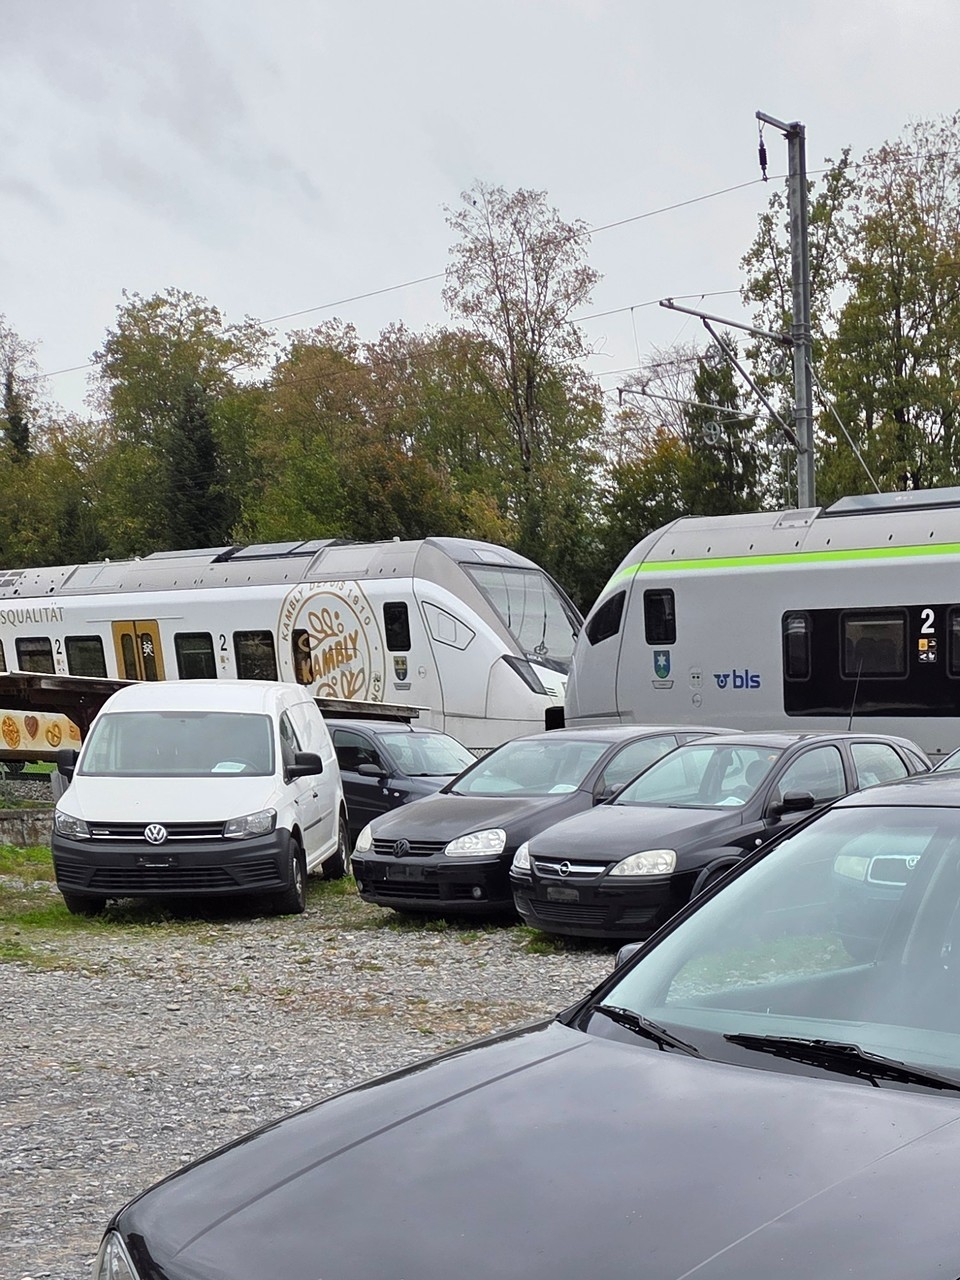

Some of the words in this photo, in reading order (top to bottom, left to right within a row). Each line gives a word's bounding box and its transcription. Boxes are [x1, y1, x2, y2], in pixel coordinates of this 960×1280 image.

[0, 602, 64, 627] SQUALITÄT
[281, 587, 304, 642] KAMBLY
[921, 608, 935, 634] 2
[54, 638, 63, 655] 2
[219, 633, 228, 652] 2
[301, 629, 359, 683] KAMBLY
[732, 669, 761, 689] bls
